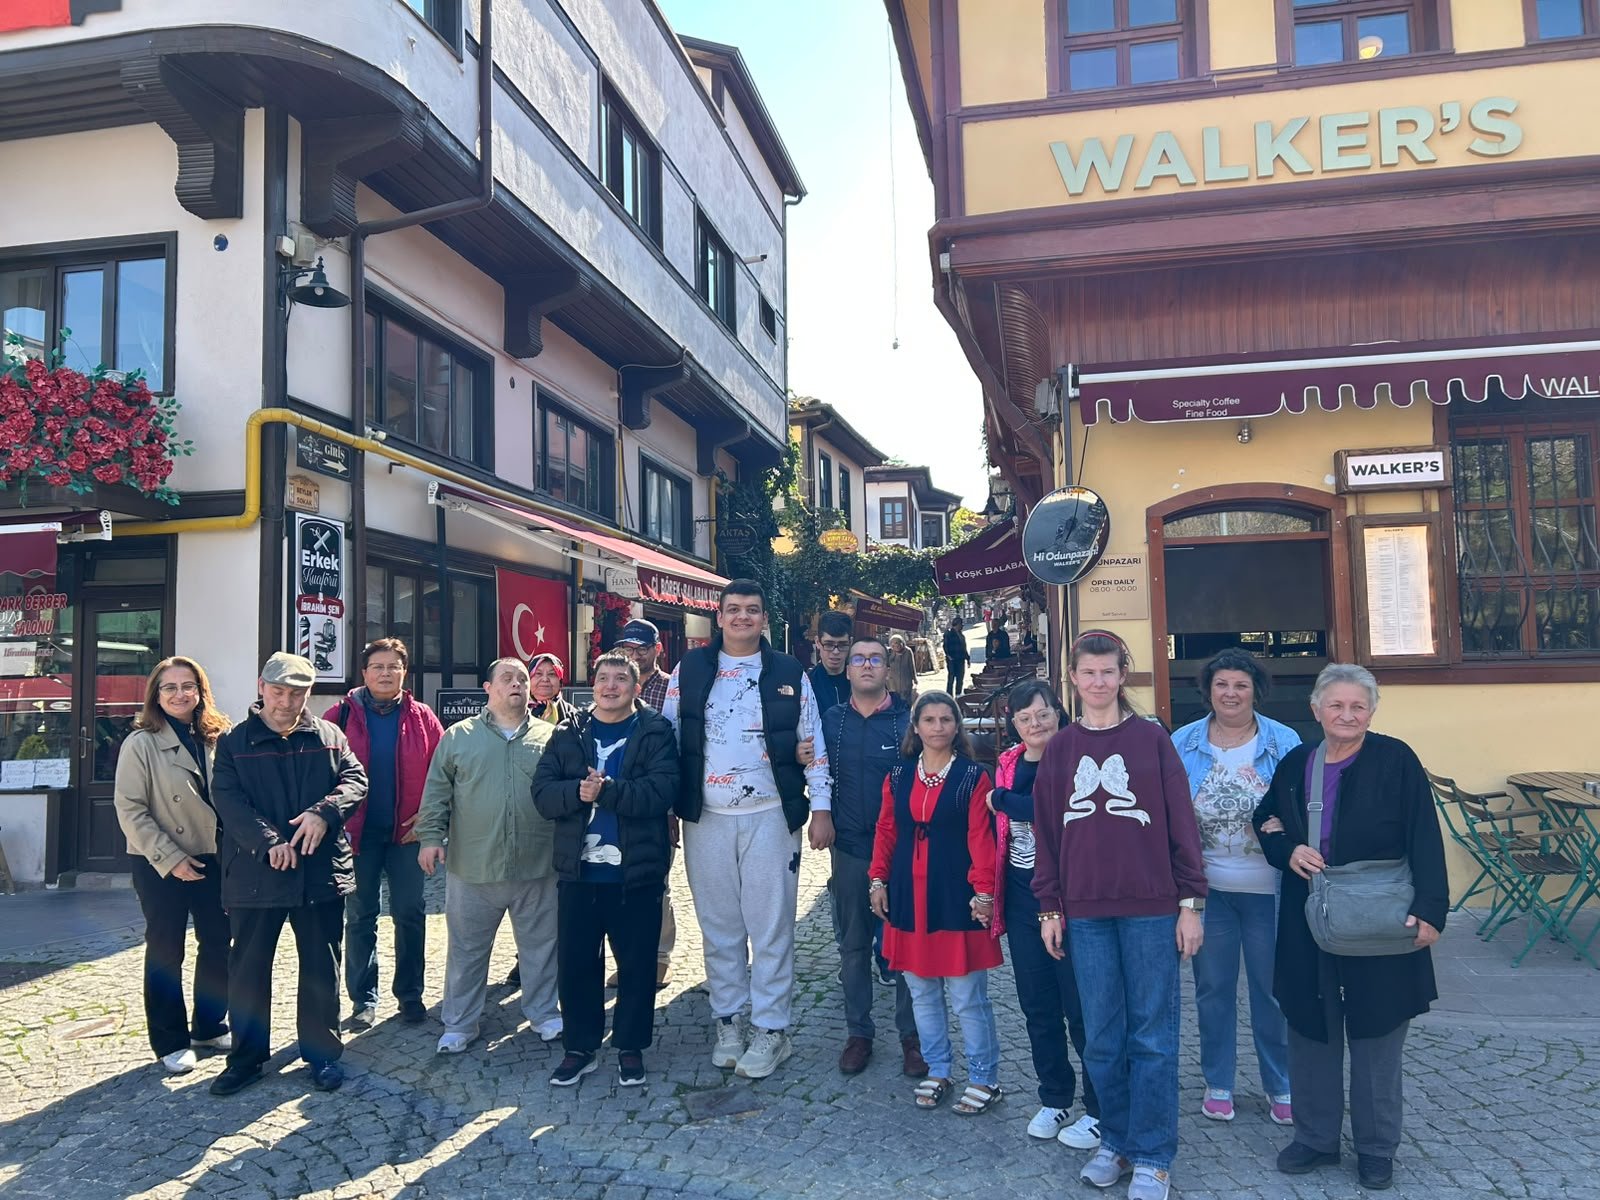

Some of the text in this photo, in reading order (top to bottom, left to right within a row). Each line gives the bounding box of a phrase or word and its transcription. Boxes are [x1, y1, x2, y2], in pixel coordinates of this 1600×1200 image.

[1049, 97, 1524, 195] WALKER'S
[1540, 375, 1600, 396] WAL
[1172, 397, 1240, 409] Specialty Coffee
[1185, 408, 1228, 418] Fine Food
[1351, 461, 1440, 476] WALKER'S
[302, 548, 339, 571] Erkek
[1033, 552, 1045, 562] Hi
[1096, 557, 1141, 566] UNPAZARI
[984, 560, 1026, 575] BALABA
[25, 593, 68, 610] BERBER
[13, 619, 54, 636] SALONU
[443, 706, 485, 715] HANIME
